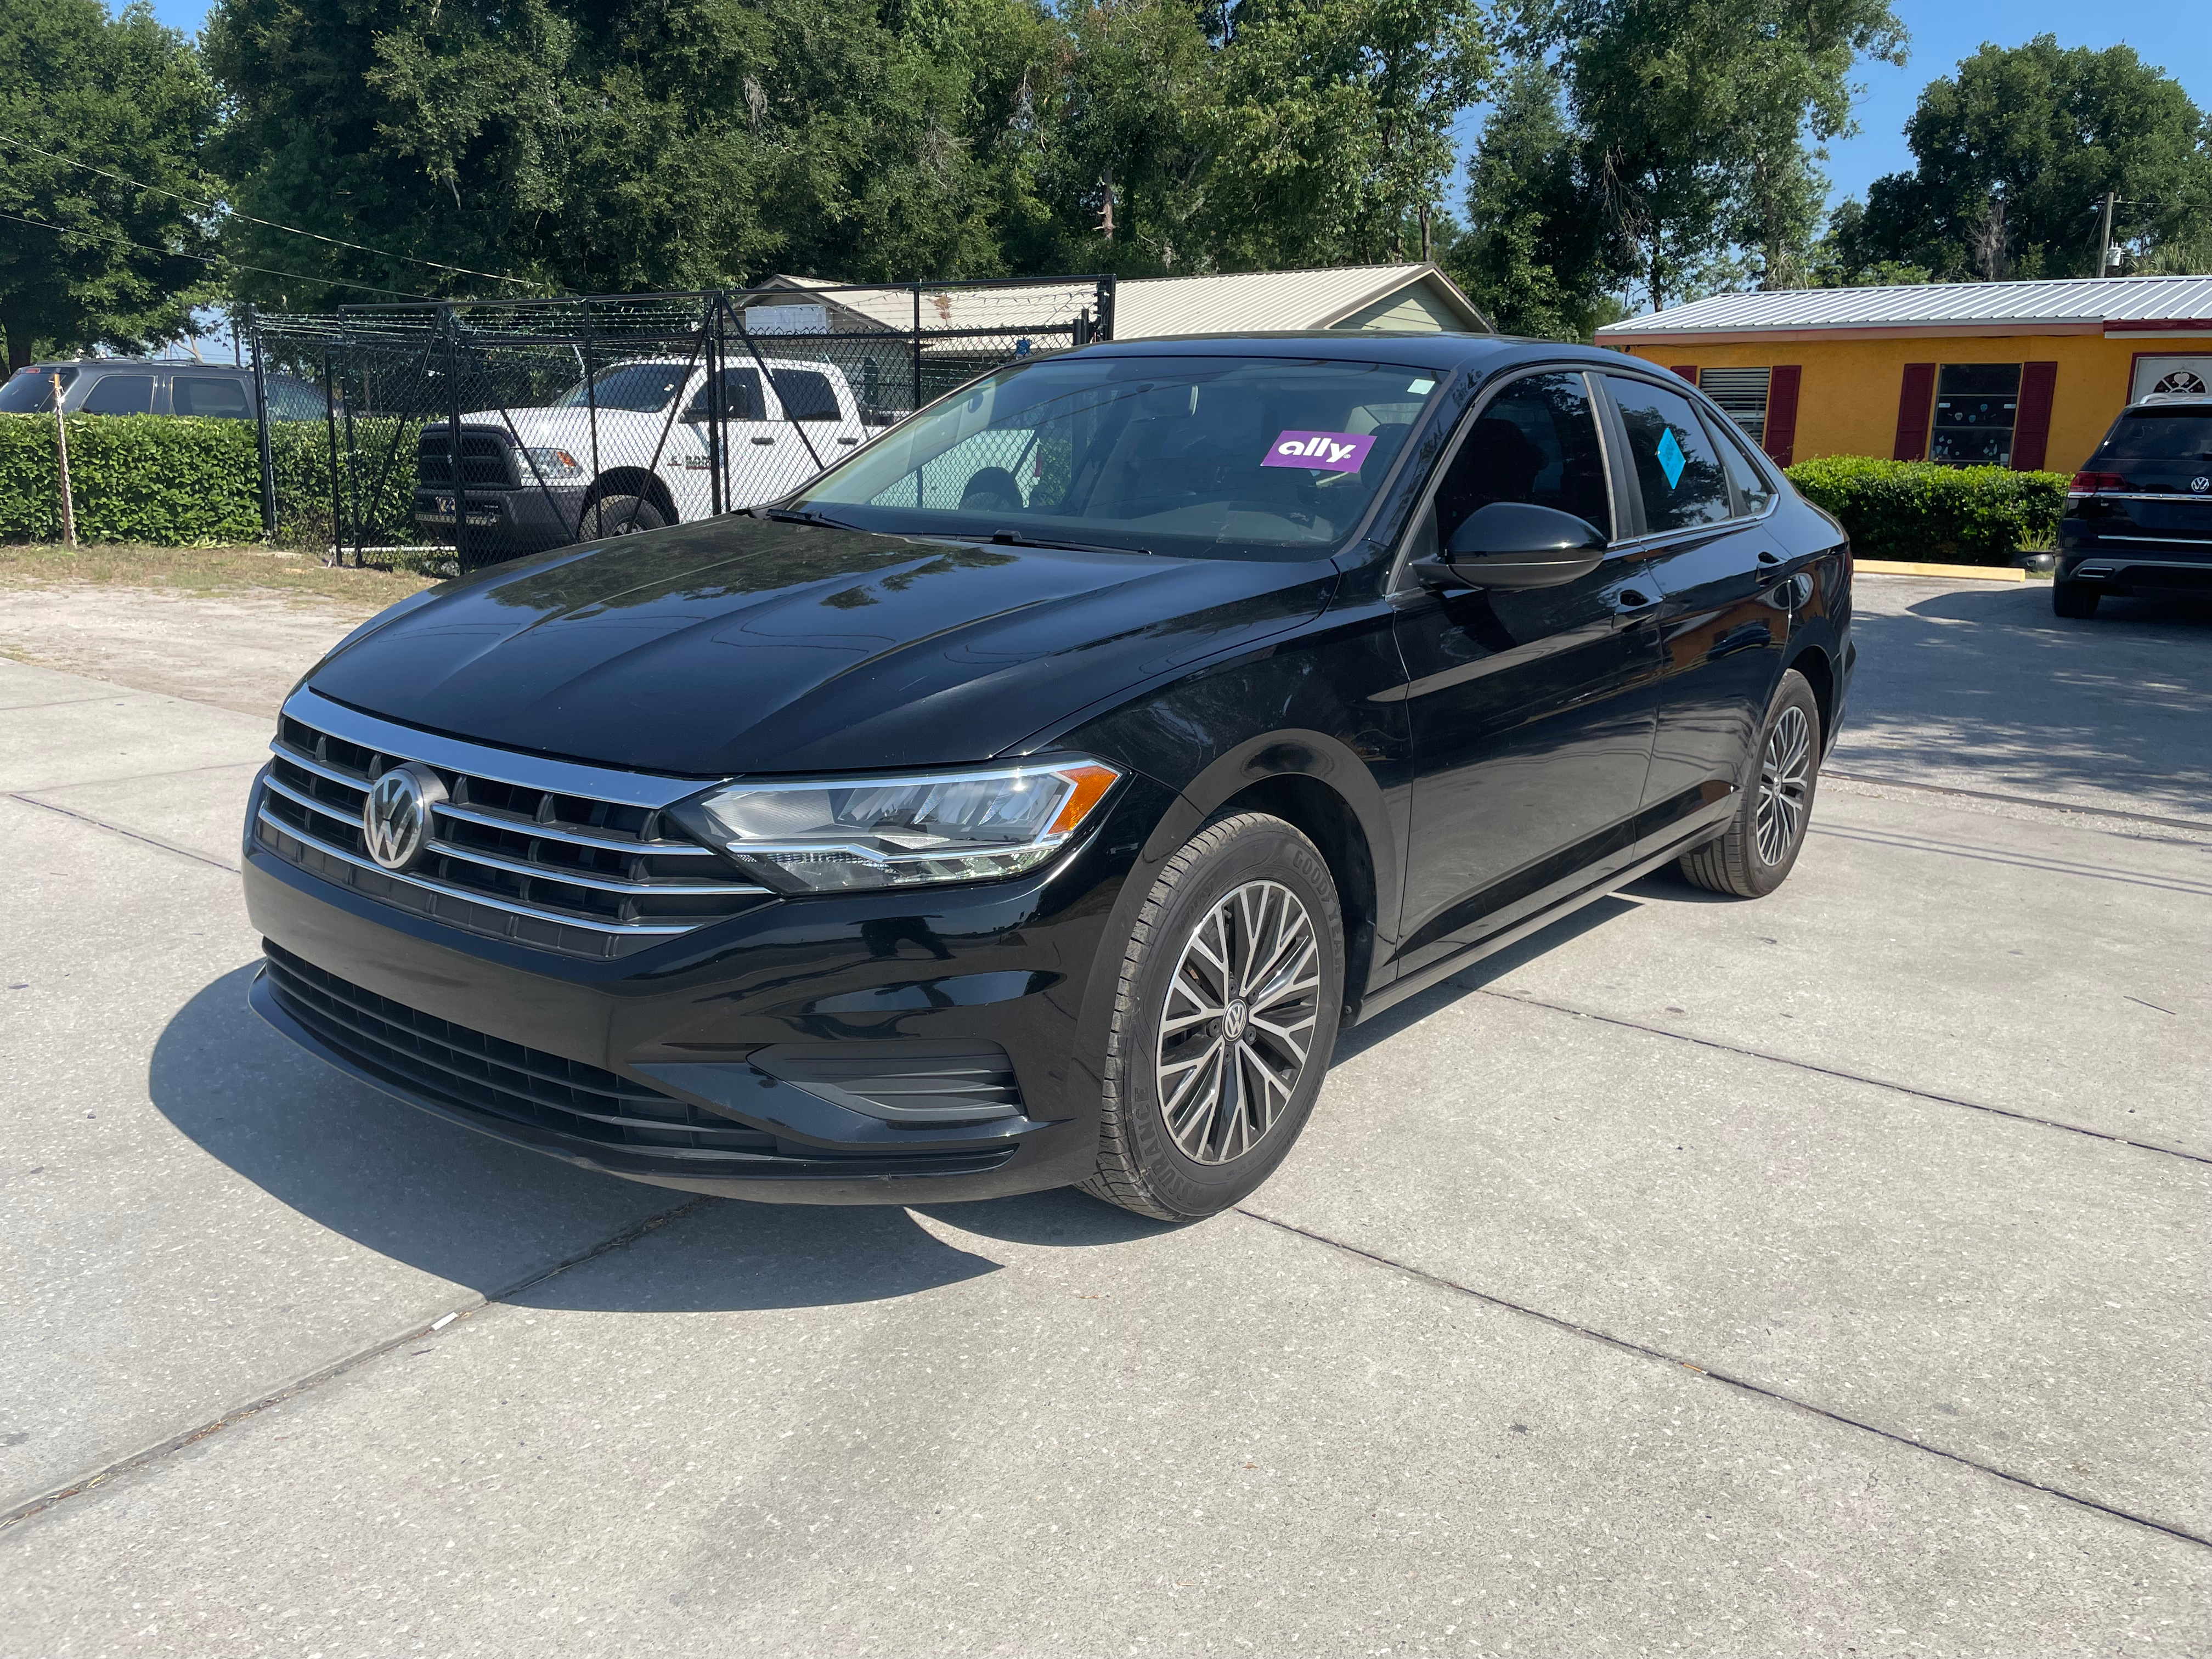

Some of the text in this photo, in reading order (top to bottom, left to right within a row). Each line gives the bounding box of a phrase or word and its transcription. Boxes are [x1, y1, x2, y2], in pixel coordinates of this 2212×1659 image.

[1278, 437, 1357, 463] ally
[364, 768, 424, 868] VW
[1293, 850, 1344, 975] GOODYEAR
[1135, 1086, 1205, 1205] ASSURANCE
